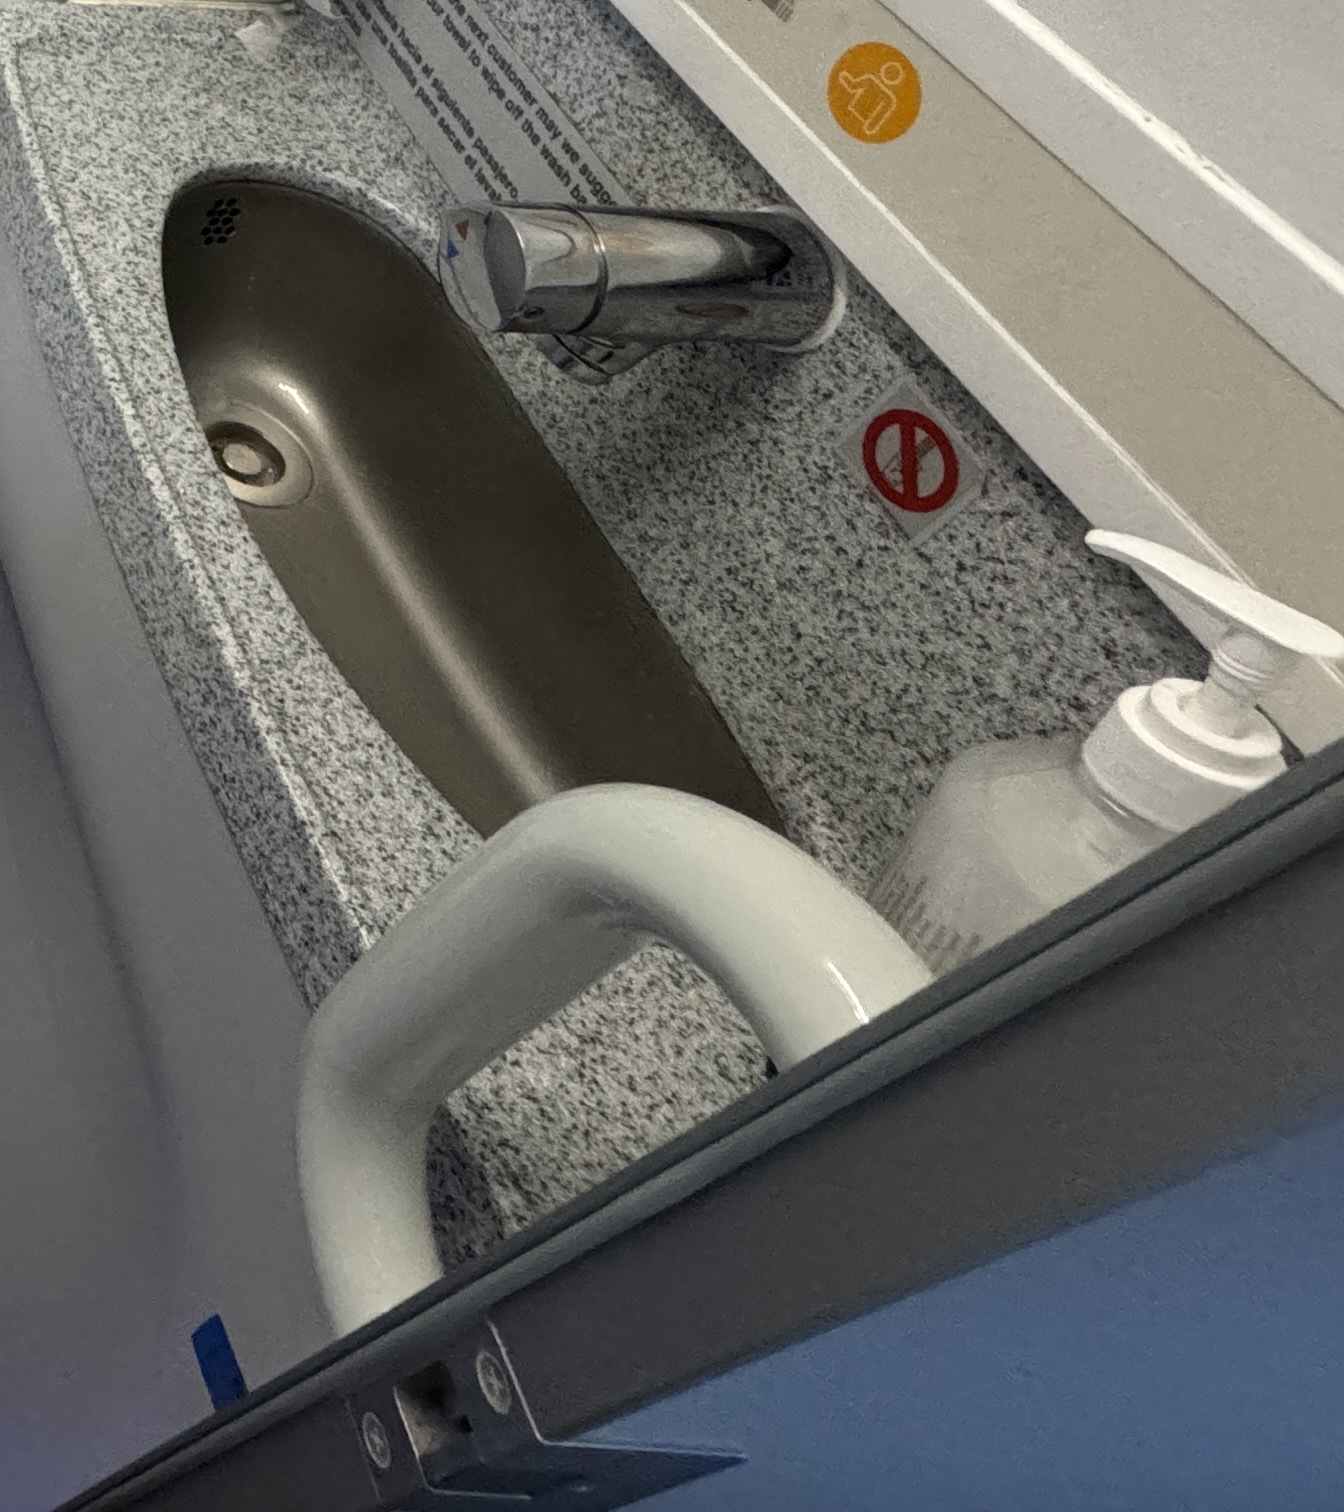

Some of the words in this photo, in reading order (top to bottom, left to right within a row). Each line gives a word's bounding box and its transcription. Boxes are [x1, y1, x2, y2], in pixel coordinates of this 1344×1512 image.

[414, 85, 439, 118] para
[437, 116, 465, 154] secar
[430, 77, 474, 139] siguiente
[471, 136, 518, 202] pasajero
[442, 13, 471, 52] towel
[467, 48, 481, 67] to
[480, 65, 506, 101] wipe
[504, 98, 524, 121] off
[520, 117, 541, 146] the
[539, 143, 572, 187] wash
[464, 14, 489, 46] next
[486, 43, 538, 106] customer
[534, 106, 562, 141] may
[561, 137, 580, 164] we
[578, 163, 616, 211] sugg
